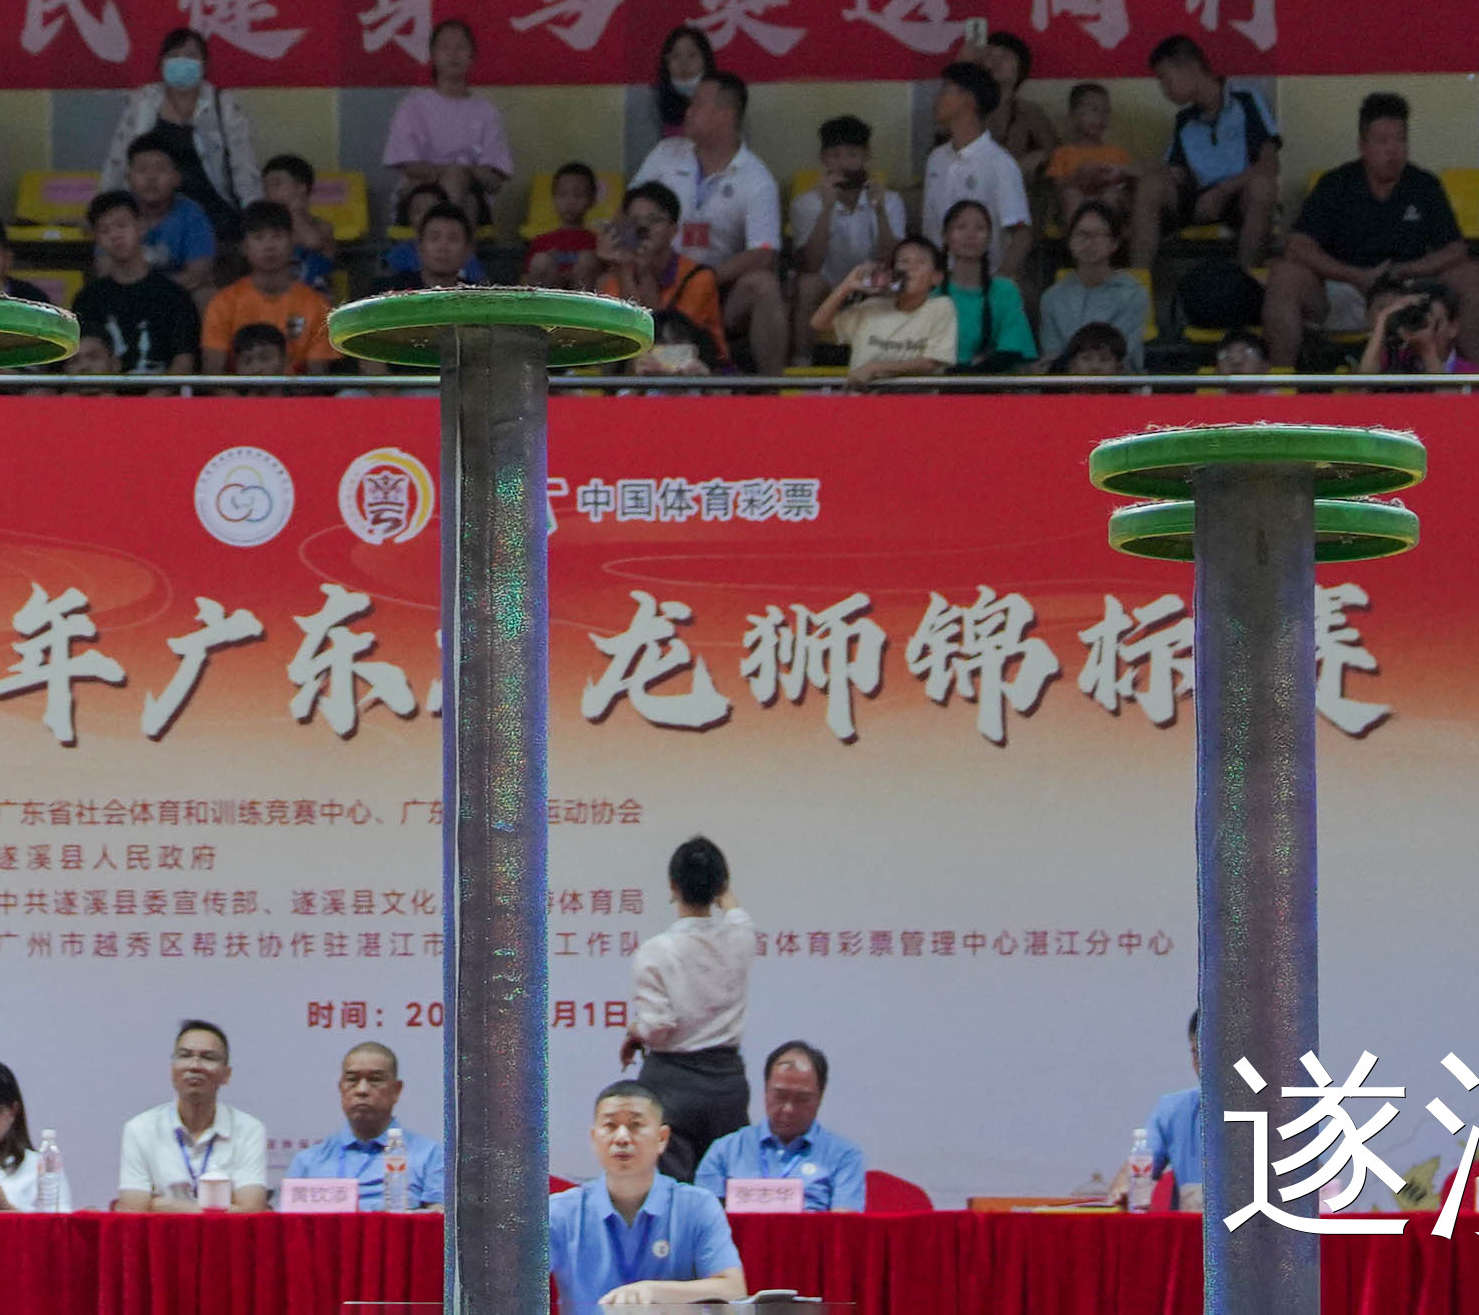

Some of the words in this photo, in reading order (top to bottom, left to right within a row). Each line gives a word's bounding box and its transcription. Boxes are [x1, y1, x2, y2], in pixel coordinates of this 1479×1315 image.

[579, 479, 810, 520] 中国体育彩票
